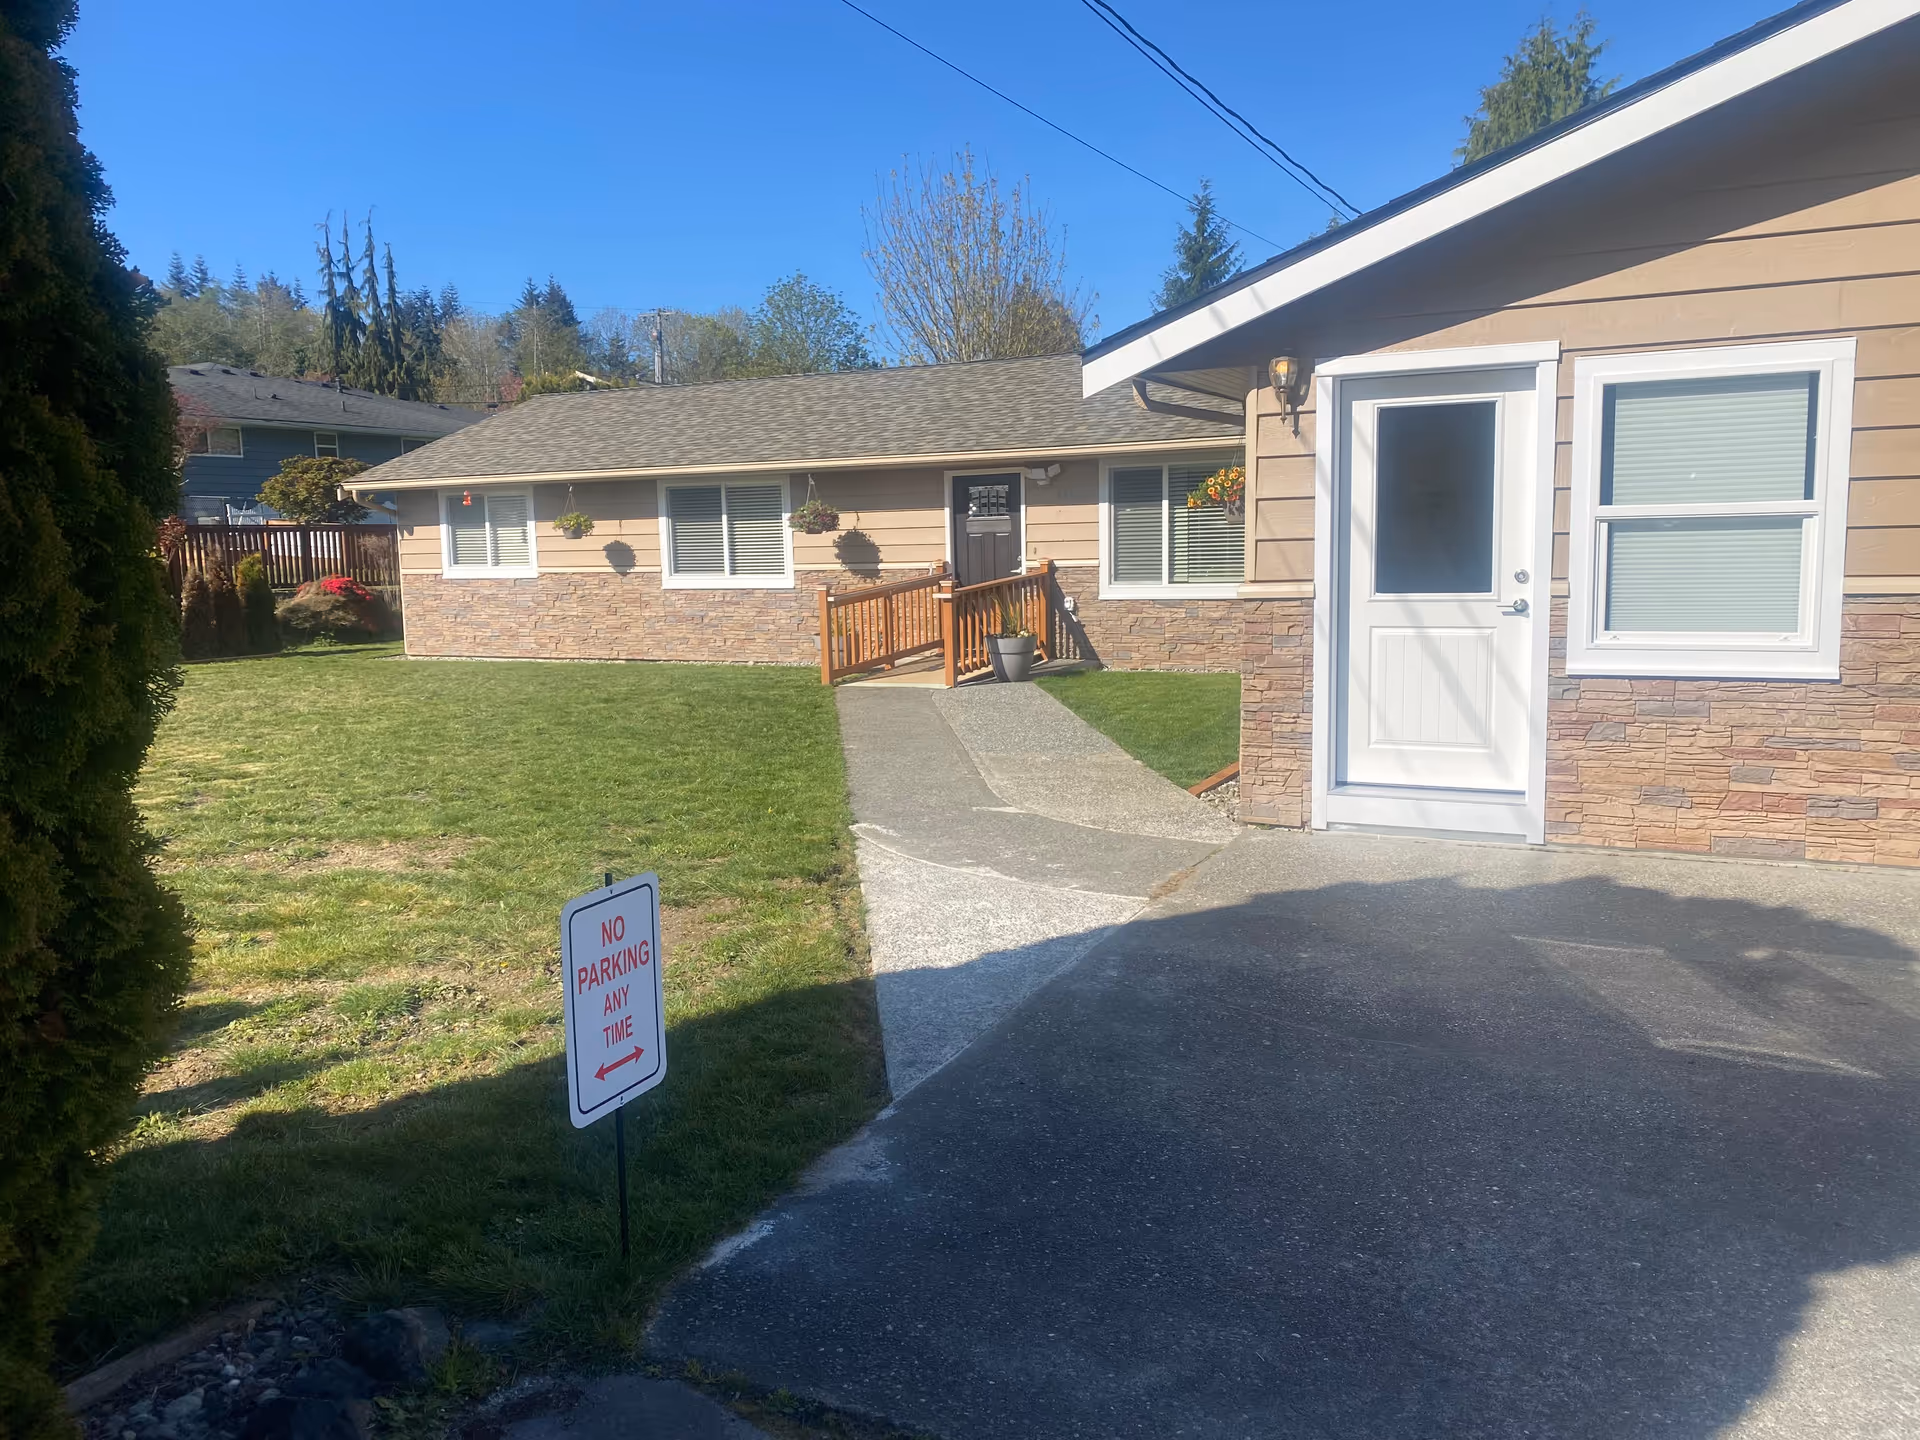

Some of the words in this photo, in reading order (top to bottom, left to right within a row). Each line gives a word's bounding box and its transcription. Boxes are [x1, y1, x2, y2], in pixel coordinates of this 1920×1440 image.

[602, 915, 625, 947] NO
[578, 940, 649, 994] PARKING
[604, 984, 629, 1016] ANY
[603, 1015, 633, 1048] TIME
